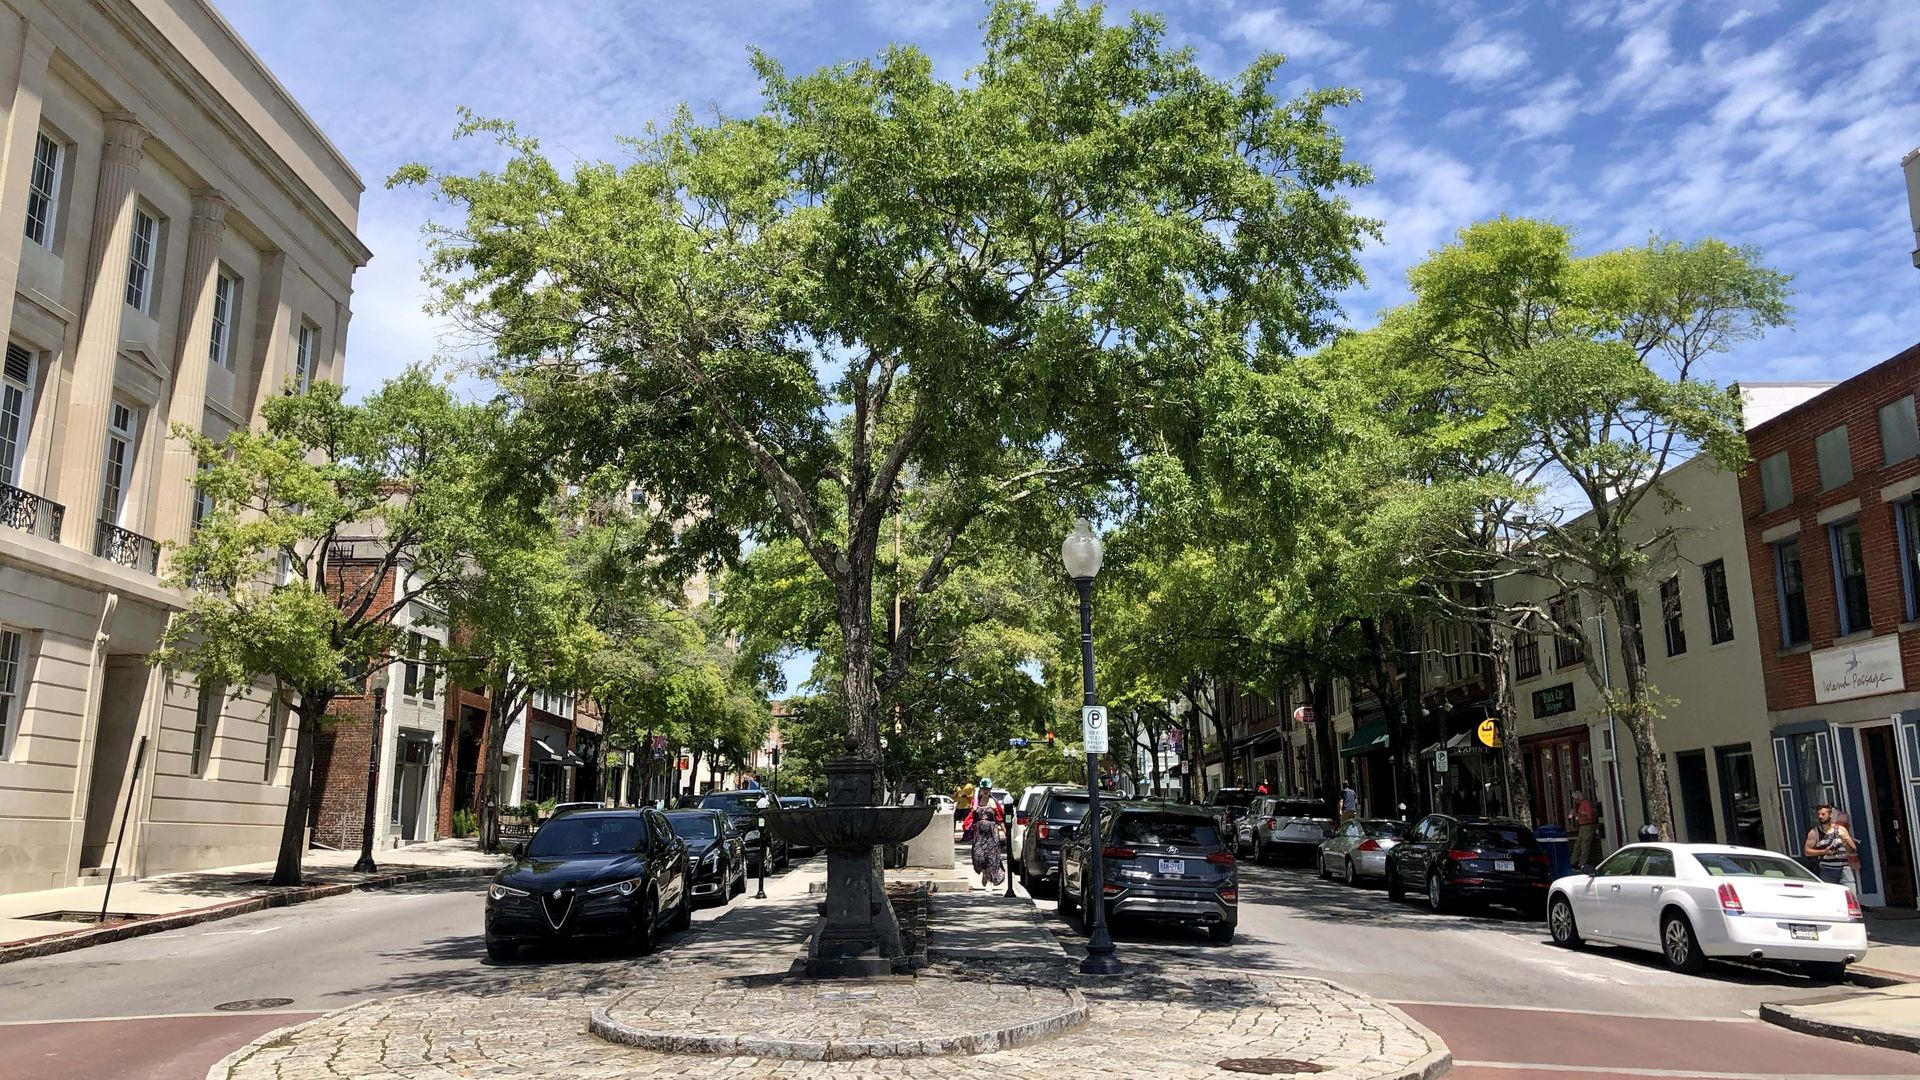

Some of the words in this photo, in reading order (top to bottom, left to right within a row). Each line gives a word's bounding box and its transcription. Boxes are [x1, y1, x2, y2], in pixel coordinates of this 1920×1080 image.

[1823, 676, 1850, 693] Island
[1852, 673, 1893, 688] Passage
[1092, 713, 1100, 725] P
